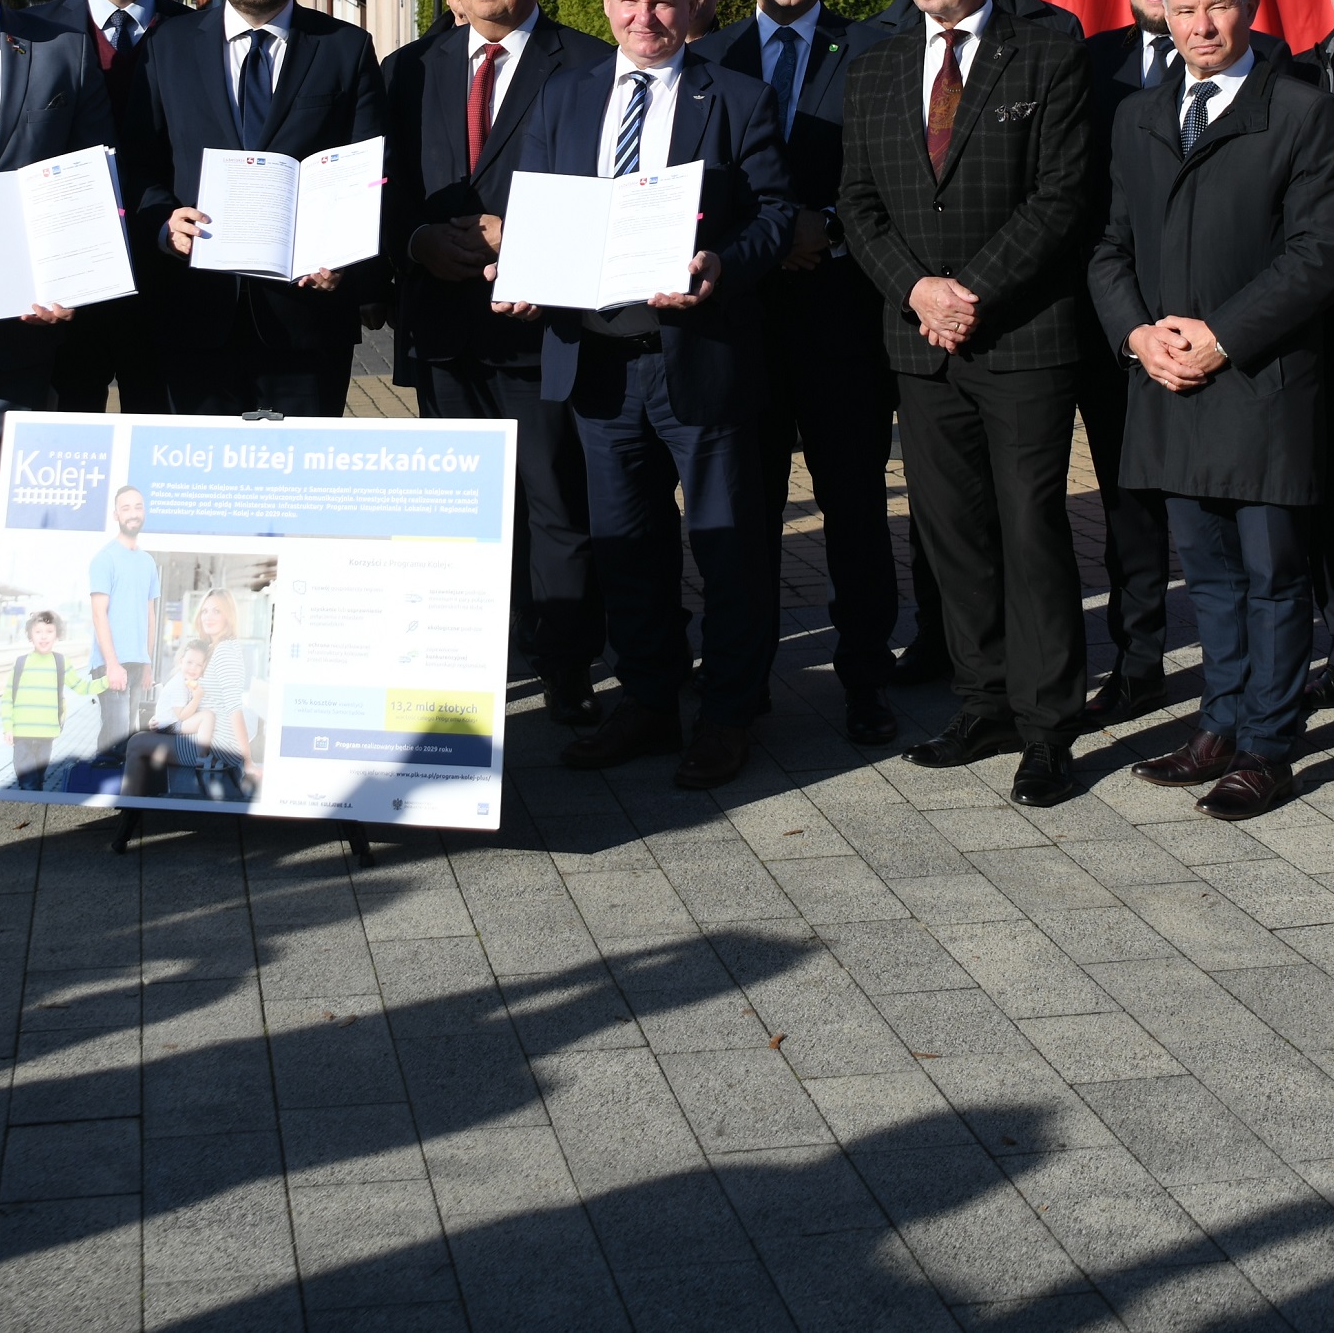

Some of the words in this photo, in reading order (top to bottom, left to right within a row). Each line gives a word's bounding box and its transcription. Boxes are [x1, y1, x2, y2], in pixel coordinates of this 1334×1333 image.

[49, 451, 107, 461] PROGRAM
[152, 443, 215, 473] Kolej
[223, 444, 295, 475] bliżej
[303, 446, 481, 473] mieszkańców
[390, 701, 412, 713] 13,2
[416, 701, 435, 712] mld
[438, 702, 478, 715] złotych
[335, 741, 361, 749] Program
[361, 742, 395, 751] realizowany
[395, 743, 414, 752] będzie
[438, 745, 453, 753] roku
